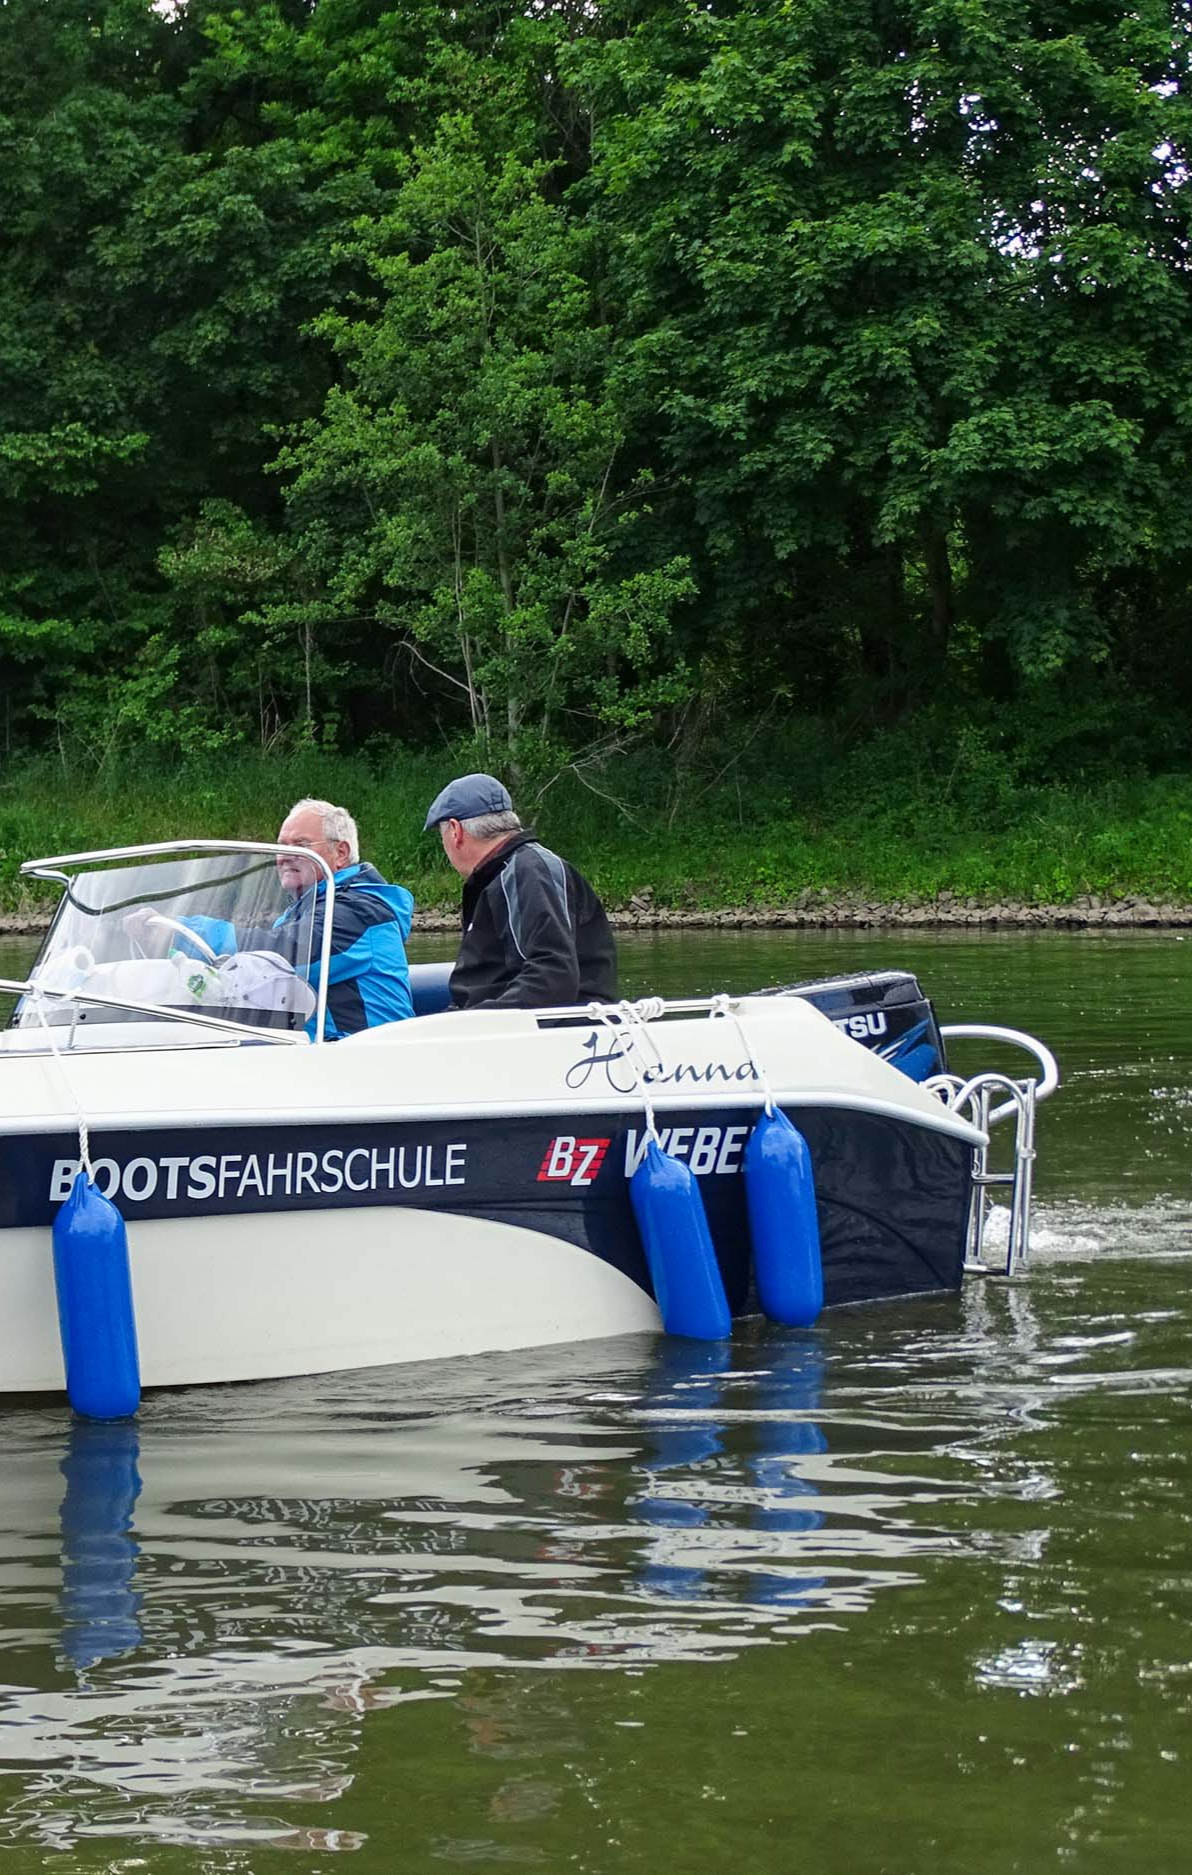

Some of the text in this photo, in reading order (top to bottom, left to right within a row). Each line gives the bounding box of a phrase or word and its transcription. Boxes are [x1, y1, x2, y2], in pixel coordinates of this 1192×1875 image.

[565, 1031, 764, 1093] Hanna
[49, 1143, 467, 1201] BOOTSFAHRSCHULE
[624, 1126, 756, 1178] WEBE
